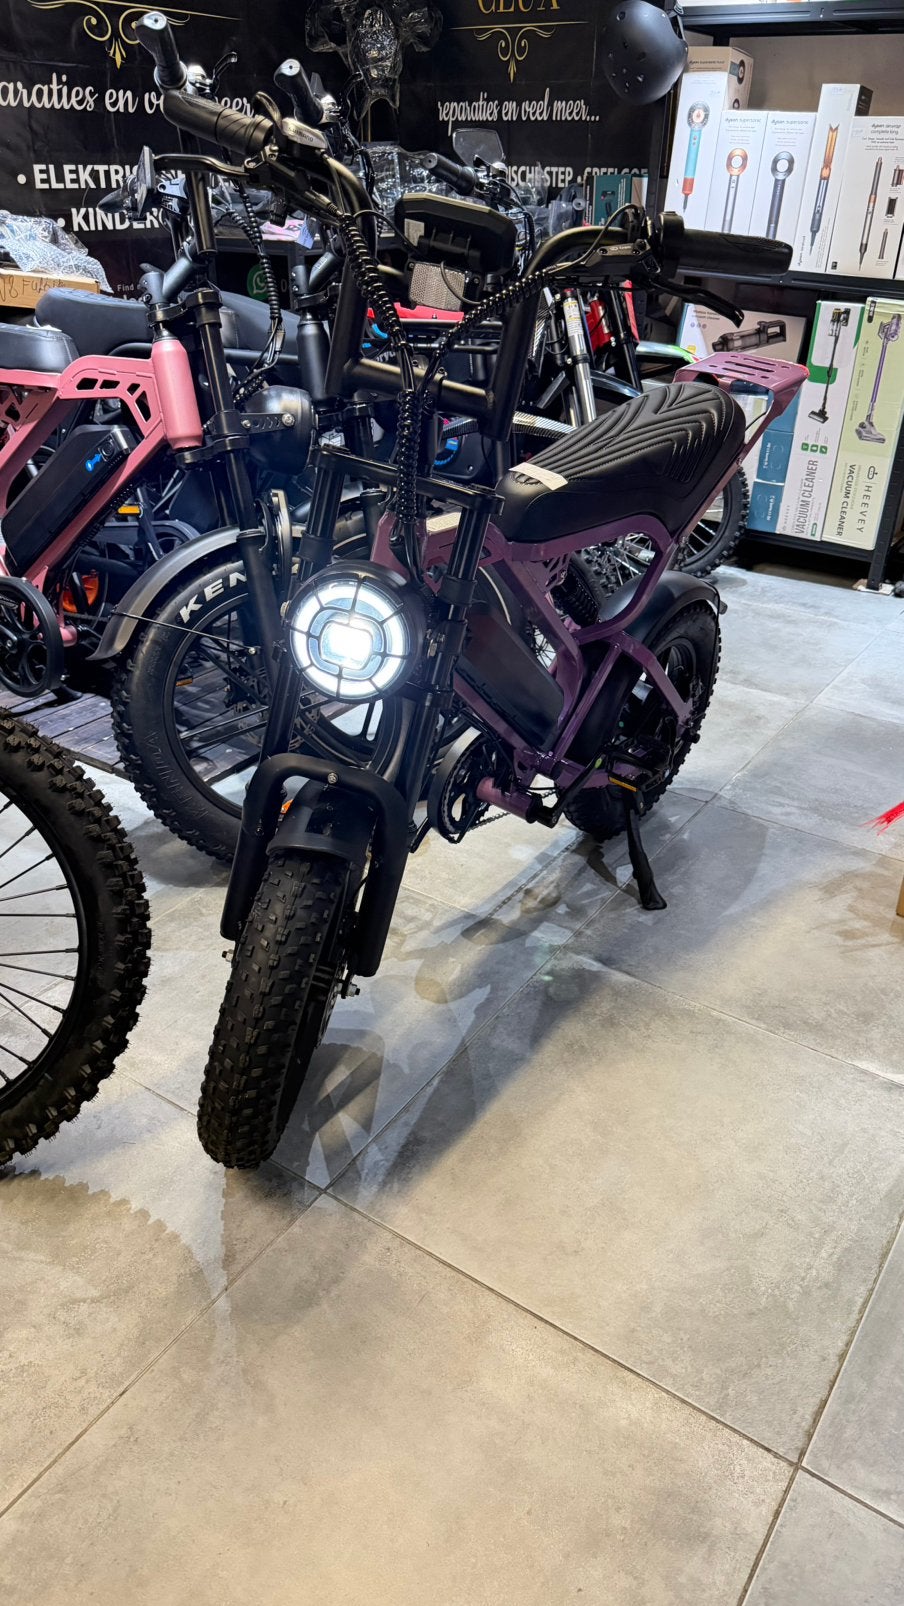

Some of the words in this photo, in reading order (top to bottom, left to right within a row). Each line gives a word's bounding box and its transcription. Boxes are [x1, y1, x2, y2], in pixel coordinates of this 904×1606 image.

[104, 88, 139, 113] en
[438, 91, 500, 136] reparaties
[501, 101, 520, 122] en
[521, 87, 551, 122] veel
[552, 99, 600, 122] meer...
[544, 167, 573, 188] STEP
[801, 459, 819, 498] CLEANER
[843, 463, 857, 499] VACUUM
[795, 500, 810, 534] VACUUM
[835, 500, 849, 537] CLEANER
[856, 484, 873, 533] HEEVEY
[178, 571, 249, 624] KEN
